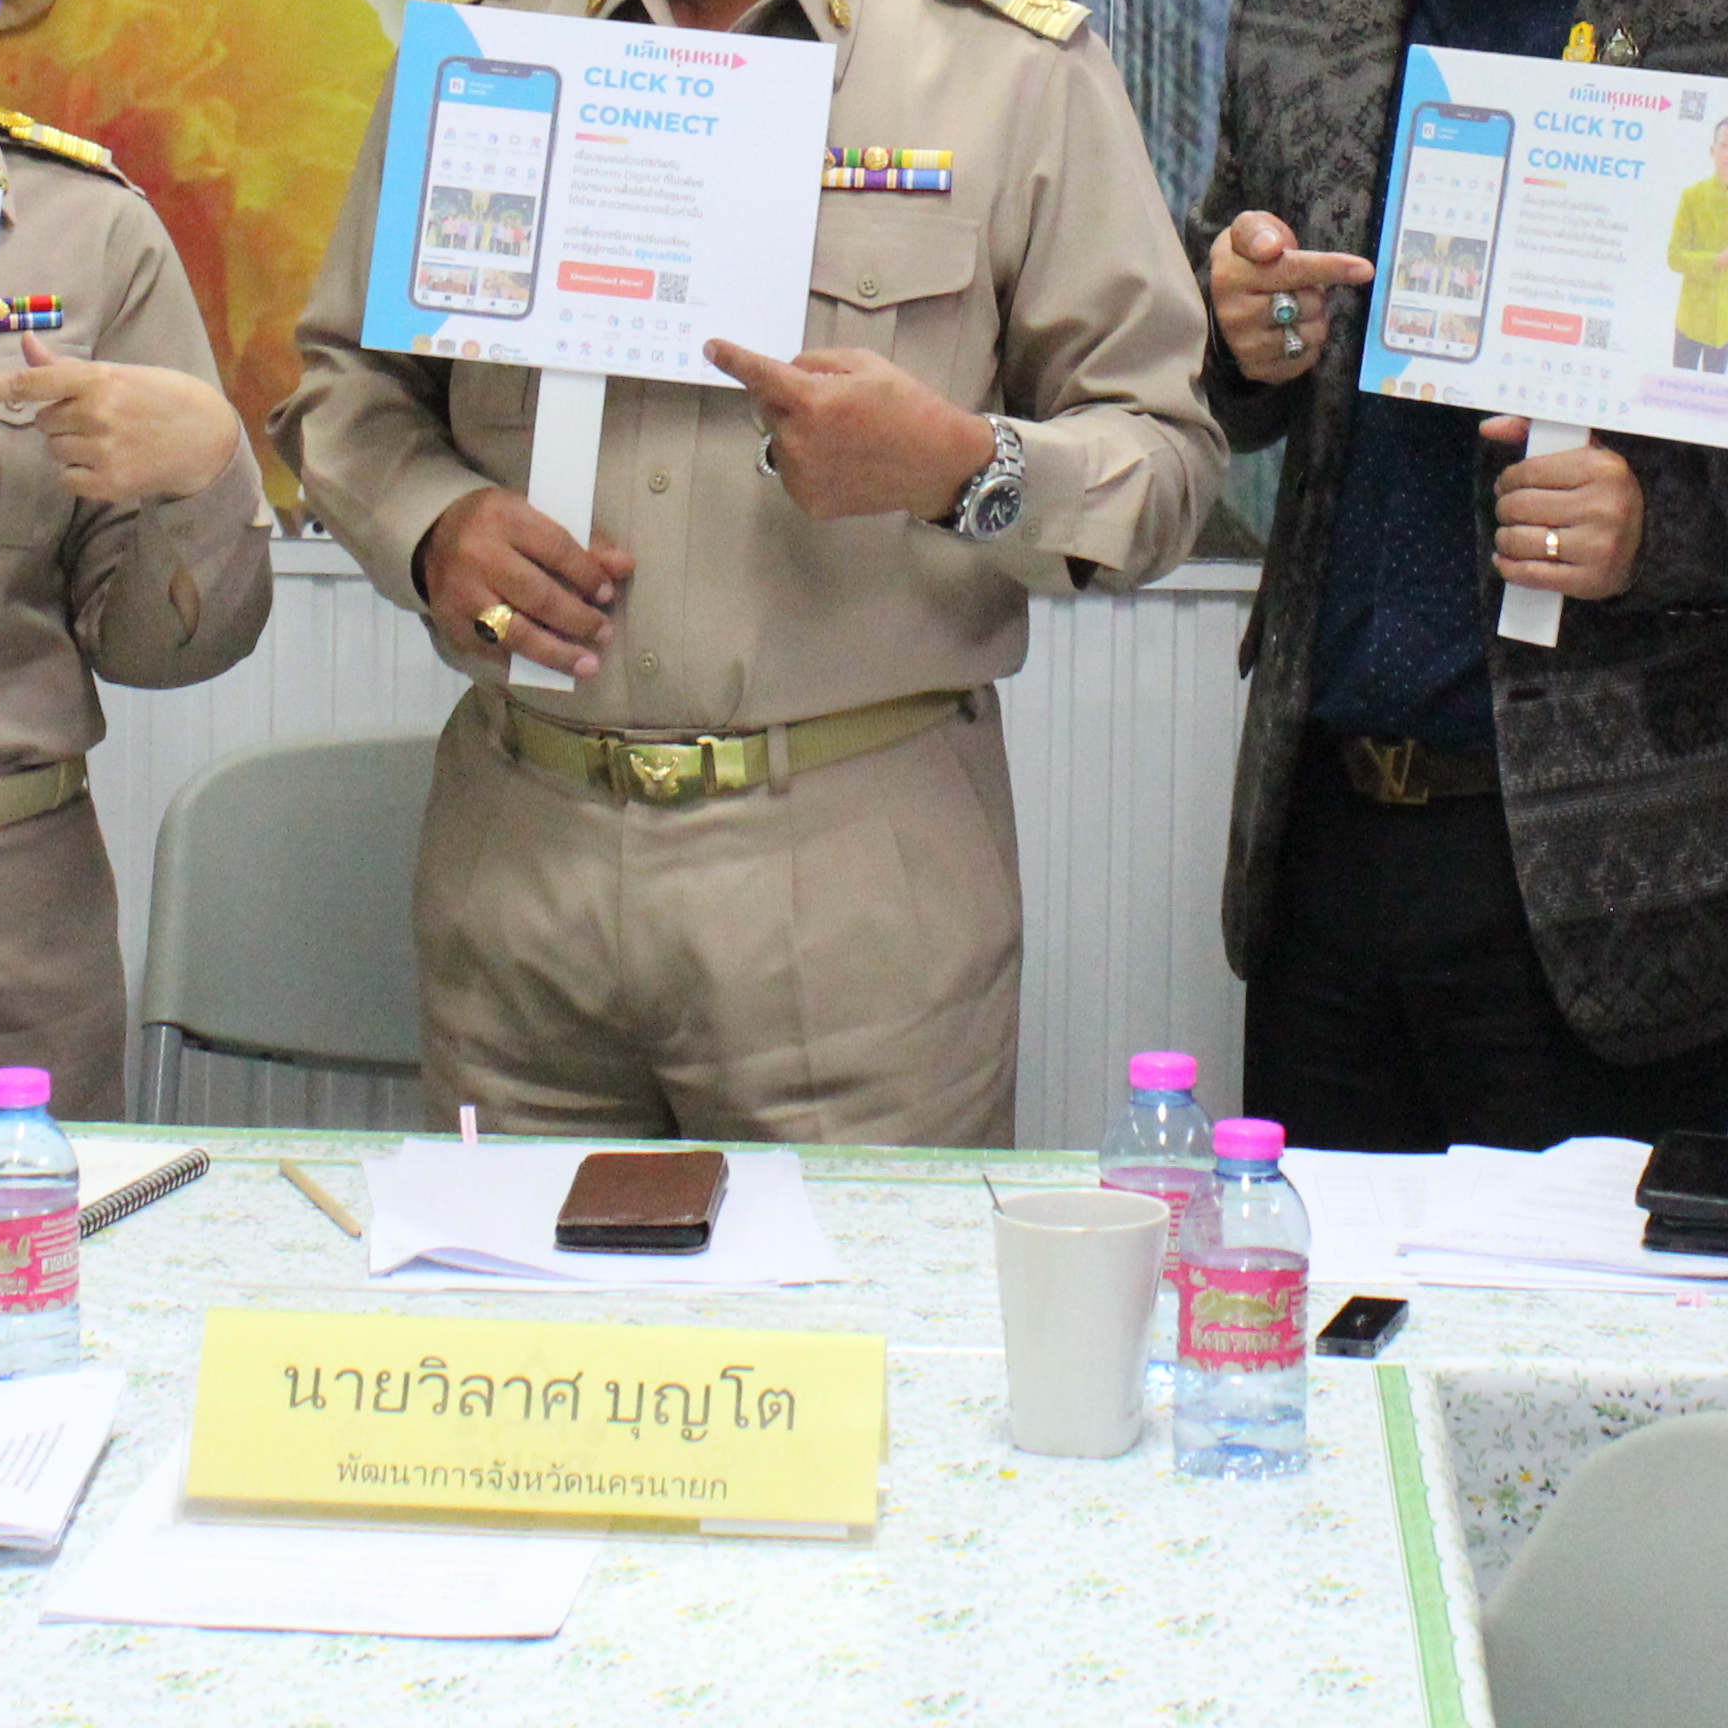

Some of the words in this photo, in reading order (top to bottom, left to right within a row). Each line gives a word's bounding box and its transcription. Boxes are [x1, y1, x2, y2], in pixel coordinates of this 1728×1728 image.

[584, 66, 667, 95] CLICK
[676, 76, 714, 98] TO
[579, 104, 719, 137] CONNECT
[1534, 111, 1603, 138] CLICK
[1613, 119, 1644, 142] TO
[573, 165, 622, 180] Platform
[624, 170, 661, 184] Digital
[1528, 148, 1645, 181] CONNECT
[282, 1355, 584, 1423] นายวิลาศ
[604, 1364, 798, 1442] บุญโต
[336, 1451, 729, 1502] พัฒนาการจังหวัดนครนายก
